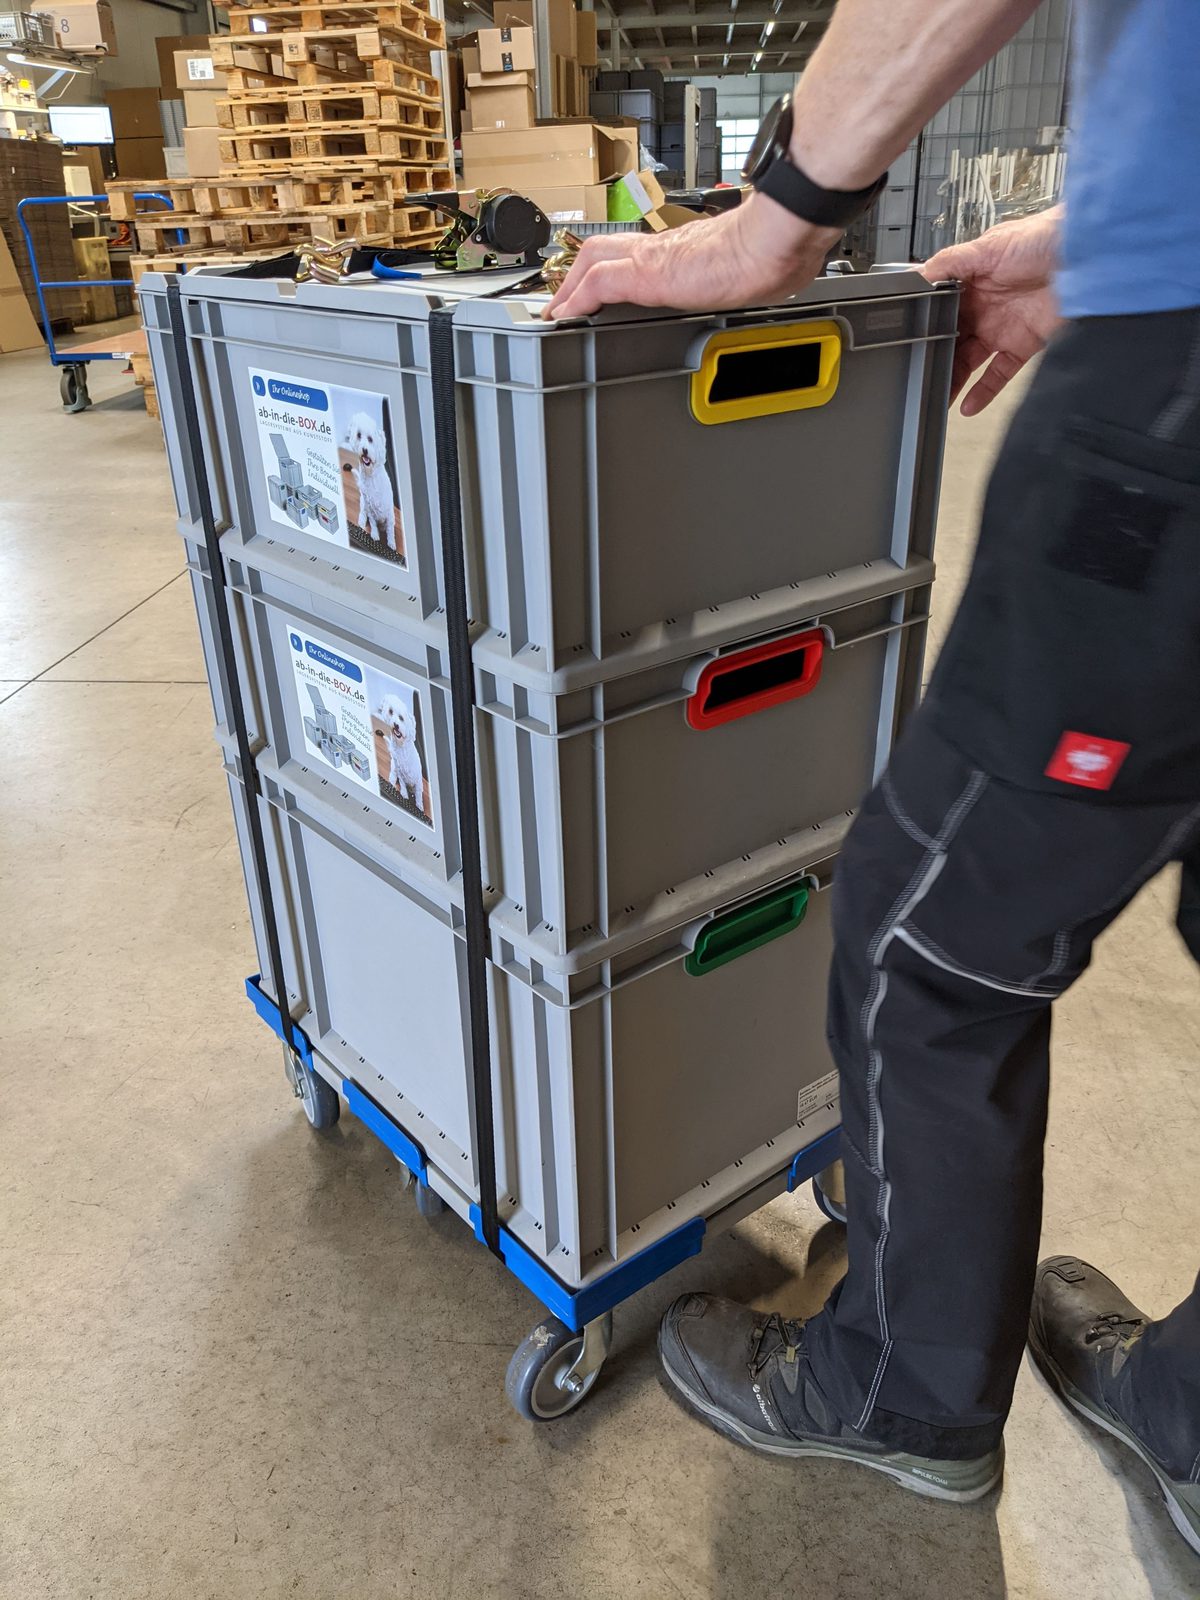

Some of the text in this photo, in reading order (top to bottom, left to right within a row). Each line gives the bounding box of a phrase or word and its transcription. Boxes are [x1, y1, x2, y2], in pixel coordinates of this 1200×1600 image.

[61, 18, 70, 33] 8
[271, 383, 311, 404] Ihr Onlineshop
[258, 406, 332, 435] ab-in-die-BOX.de
[295, 659, 365, 703] ab-in-die-BOX.de
